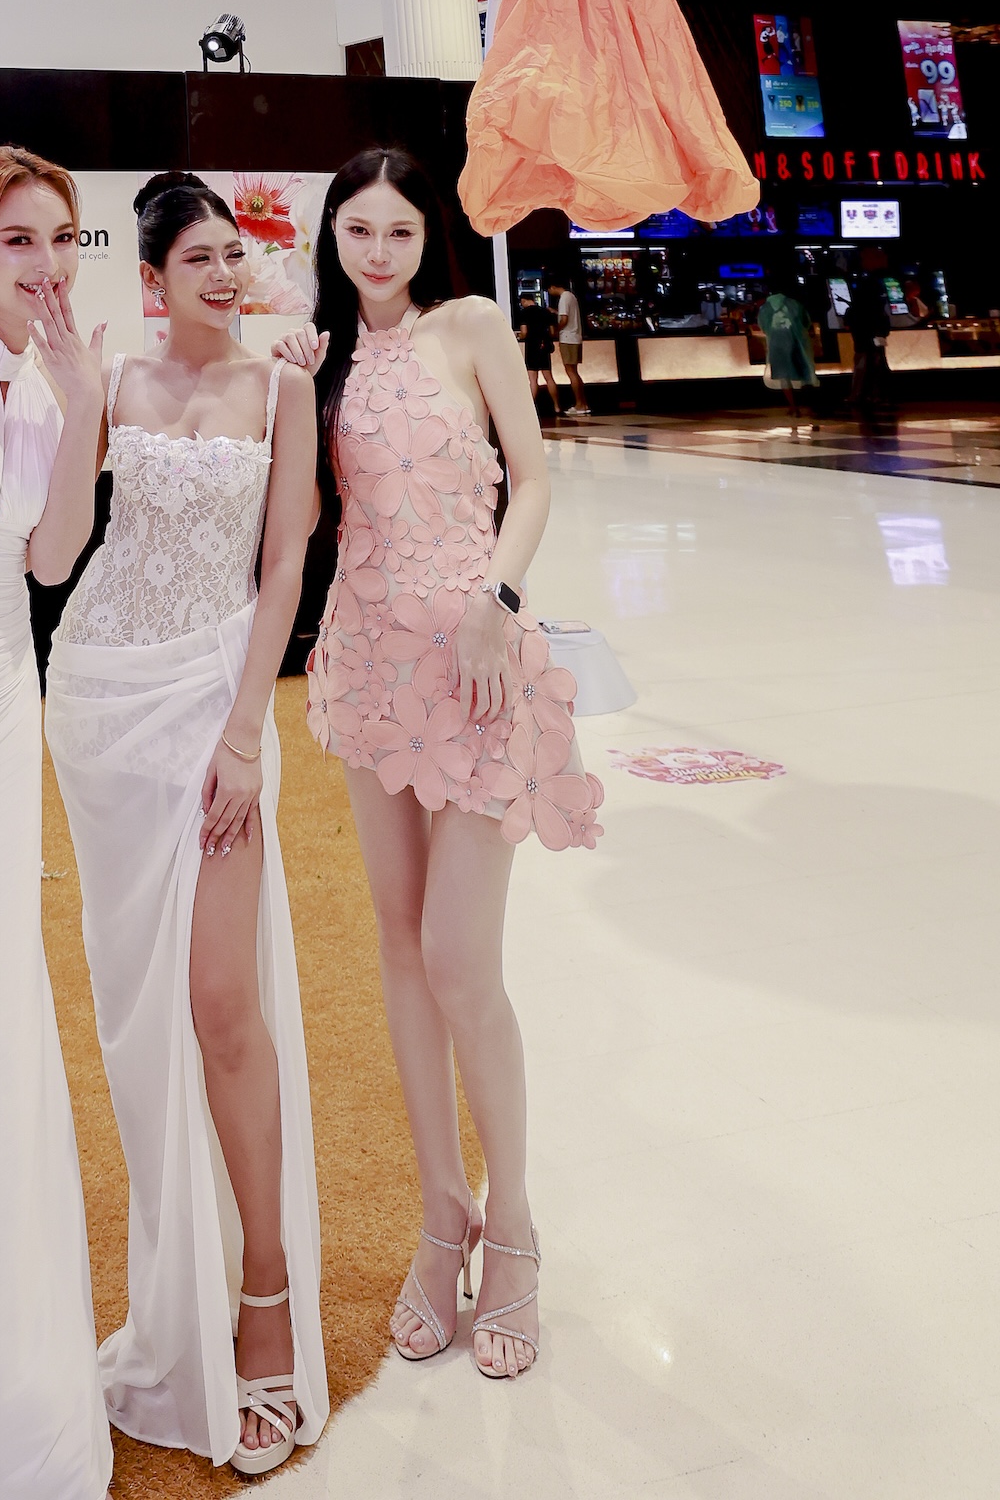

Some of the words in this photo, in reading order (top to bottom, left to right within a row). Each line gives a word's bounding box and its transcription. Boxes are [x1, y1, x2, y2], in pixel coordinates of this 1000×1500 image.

[920, 59, 956, 85] 99
[777, 153, 792, 180] &
[801, 151, 880, 180] SOFT
[894, 151, 986, 180] DRINK
[89, 252, 111, 261] cycle.
